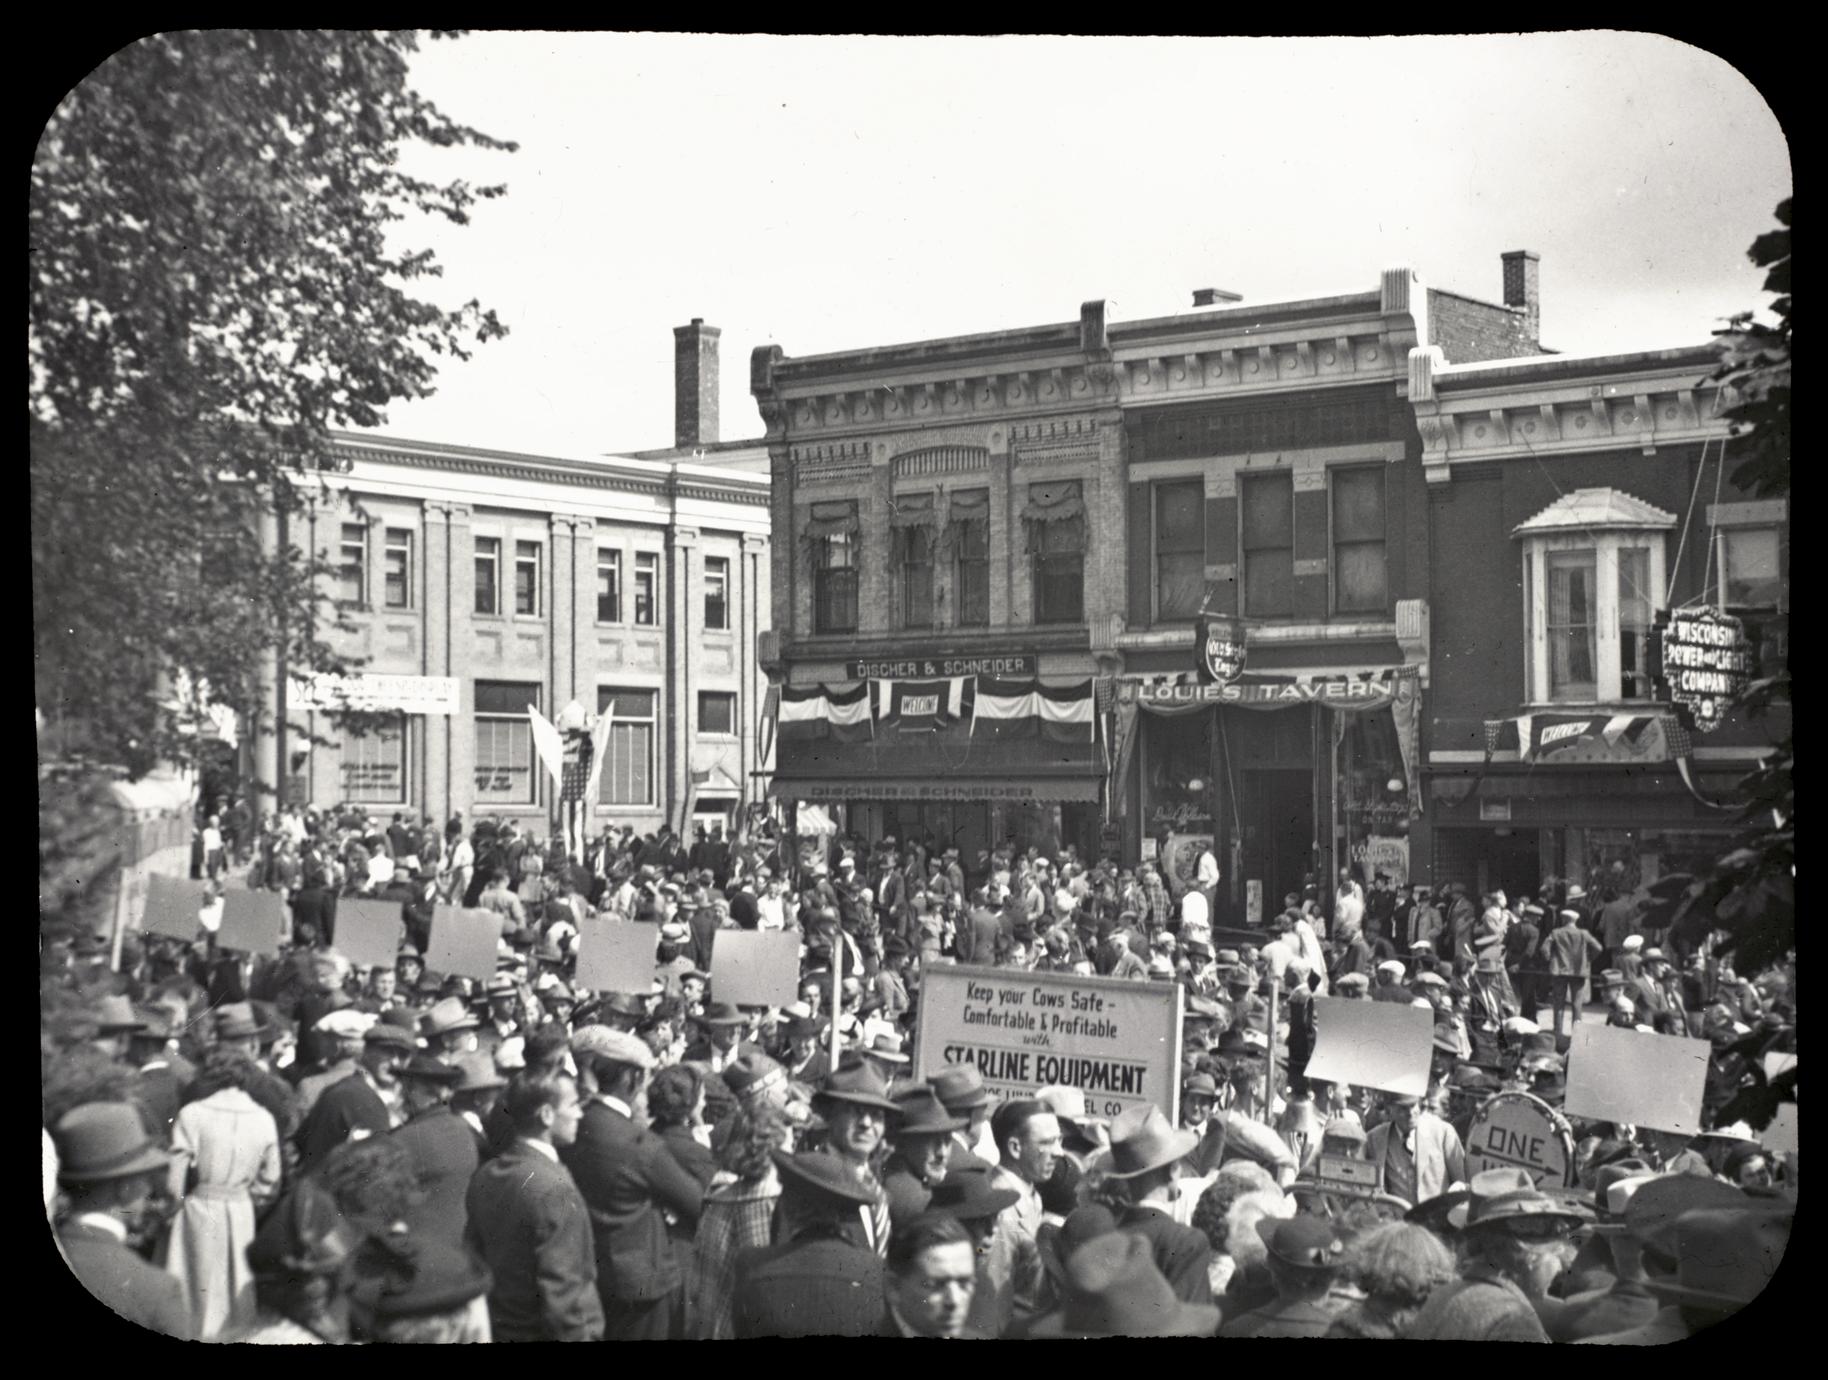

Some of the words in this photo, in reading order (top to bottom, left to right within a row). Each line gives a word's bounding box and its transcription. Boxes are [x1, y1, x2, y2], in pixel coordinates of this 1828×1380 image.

[1677, 621, 1736, 646] WISCONSIN
[857, 661, 917, 678] DISCHER
[924, 661, 936, 676] &
[943, 657, 1025, 676] SCHNEIDER
[1668, 645, 1703, 667] POWER
[1716, 650, 1744, 670] LIGHT
[1138, 684, 1242, 701] LOUIES
[1263, 679, 1391, 701] TAVERN
[811, 786, 899, 797] DISCHER
[919, 786, 1034, 797] SCHNEIDER
[967, 981, 994, 1004] Keep
[999, 987, 1025, 1006] your
[1032, 987, 1065, 1009] Cows
[1071, 990, 1103, 1012] Safe
[963, 1004, 1036, 1030] Comfortable
[1040, 1014, 1048, 1031] &
[1052, 1015, 1118, 1038] Profitable
[1022, 1032, 1053, 1047] with
[943, 1045, 1030, 1082] STARLINE
[1035, 1055, 1147, 1095] EQUIPMENT
[1104, 1101, 1122, 1117] CO
[1487, 1126, 1545, 1164] ONE
